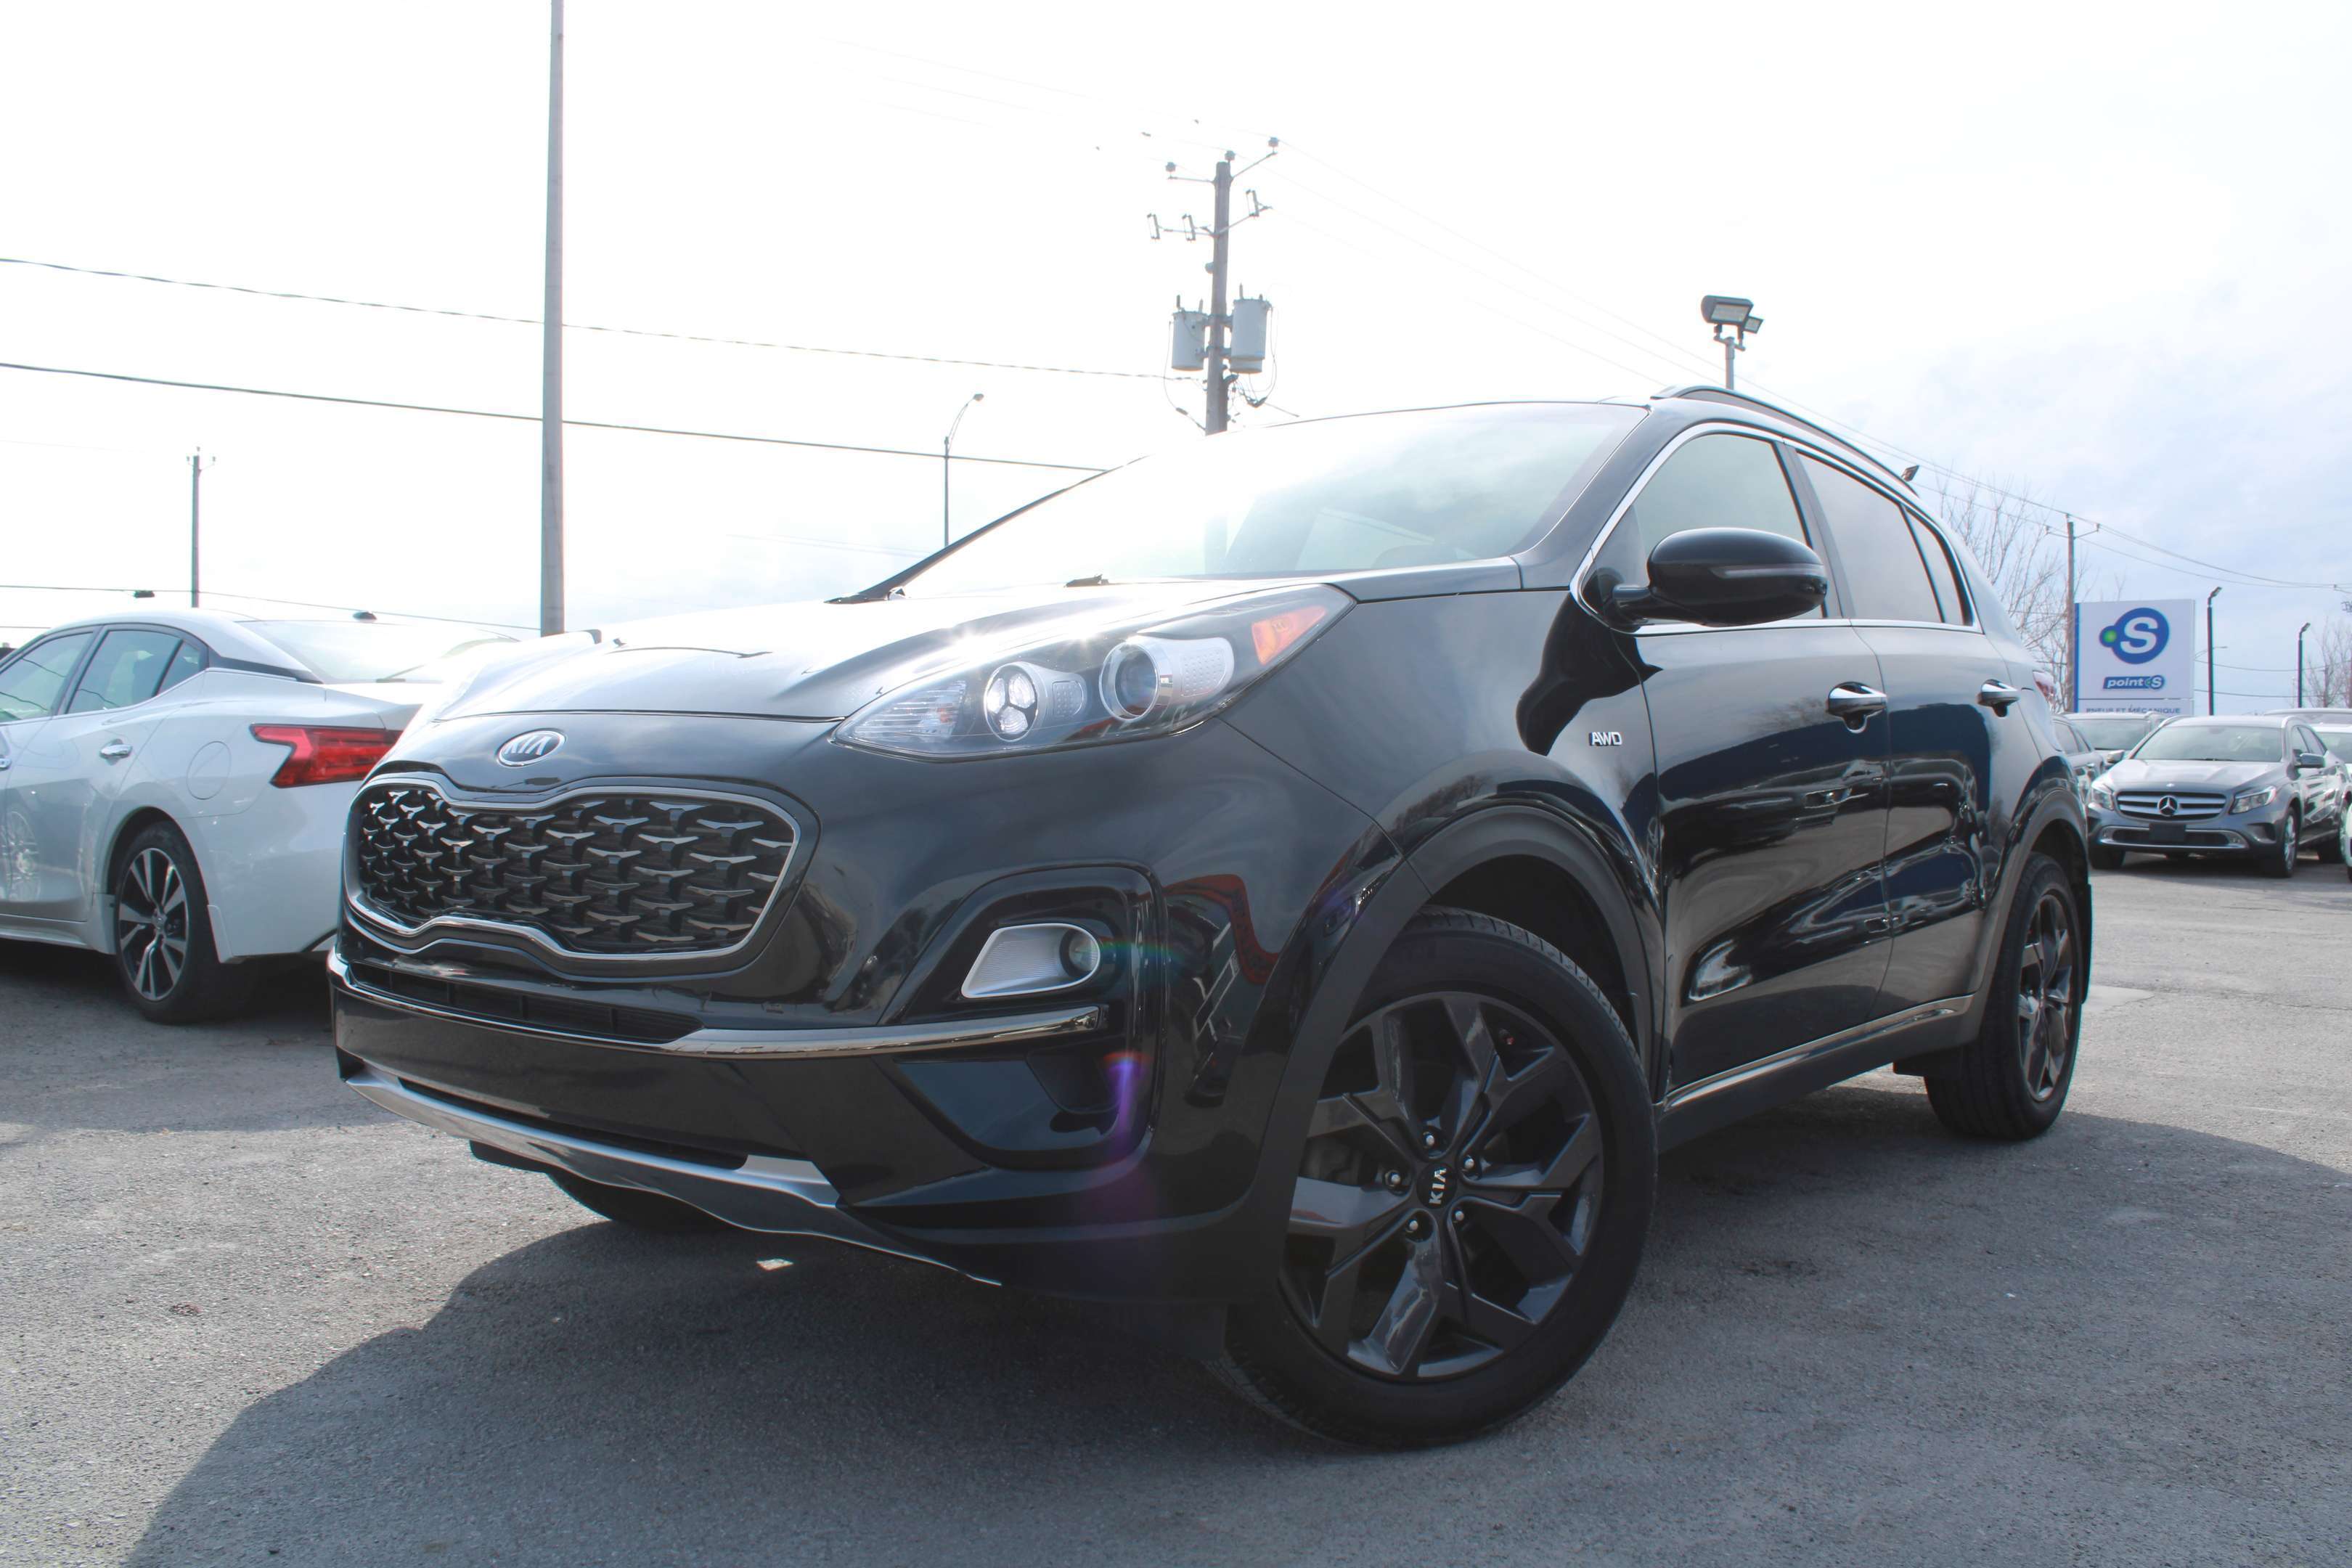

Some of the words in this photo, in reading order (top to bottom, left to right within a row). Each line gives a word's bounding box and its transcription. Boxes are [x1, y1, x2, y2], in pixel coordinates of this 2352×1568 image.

[2120, 616, 2159, 654] S
[2107, 677, 2144, 688] point
[2151, 676, 2163, 688] S
[503, 734, 552, 756] KIA
[1590, 731, 1623, 746] AWD
[1428, 1168, 1447, 1204] KIA
